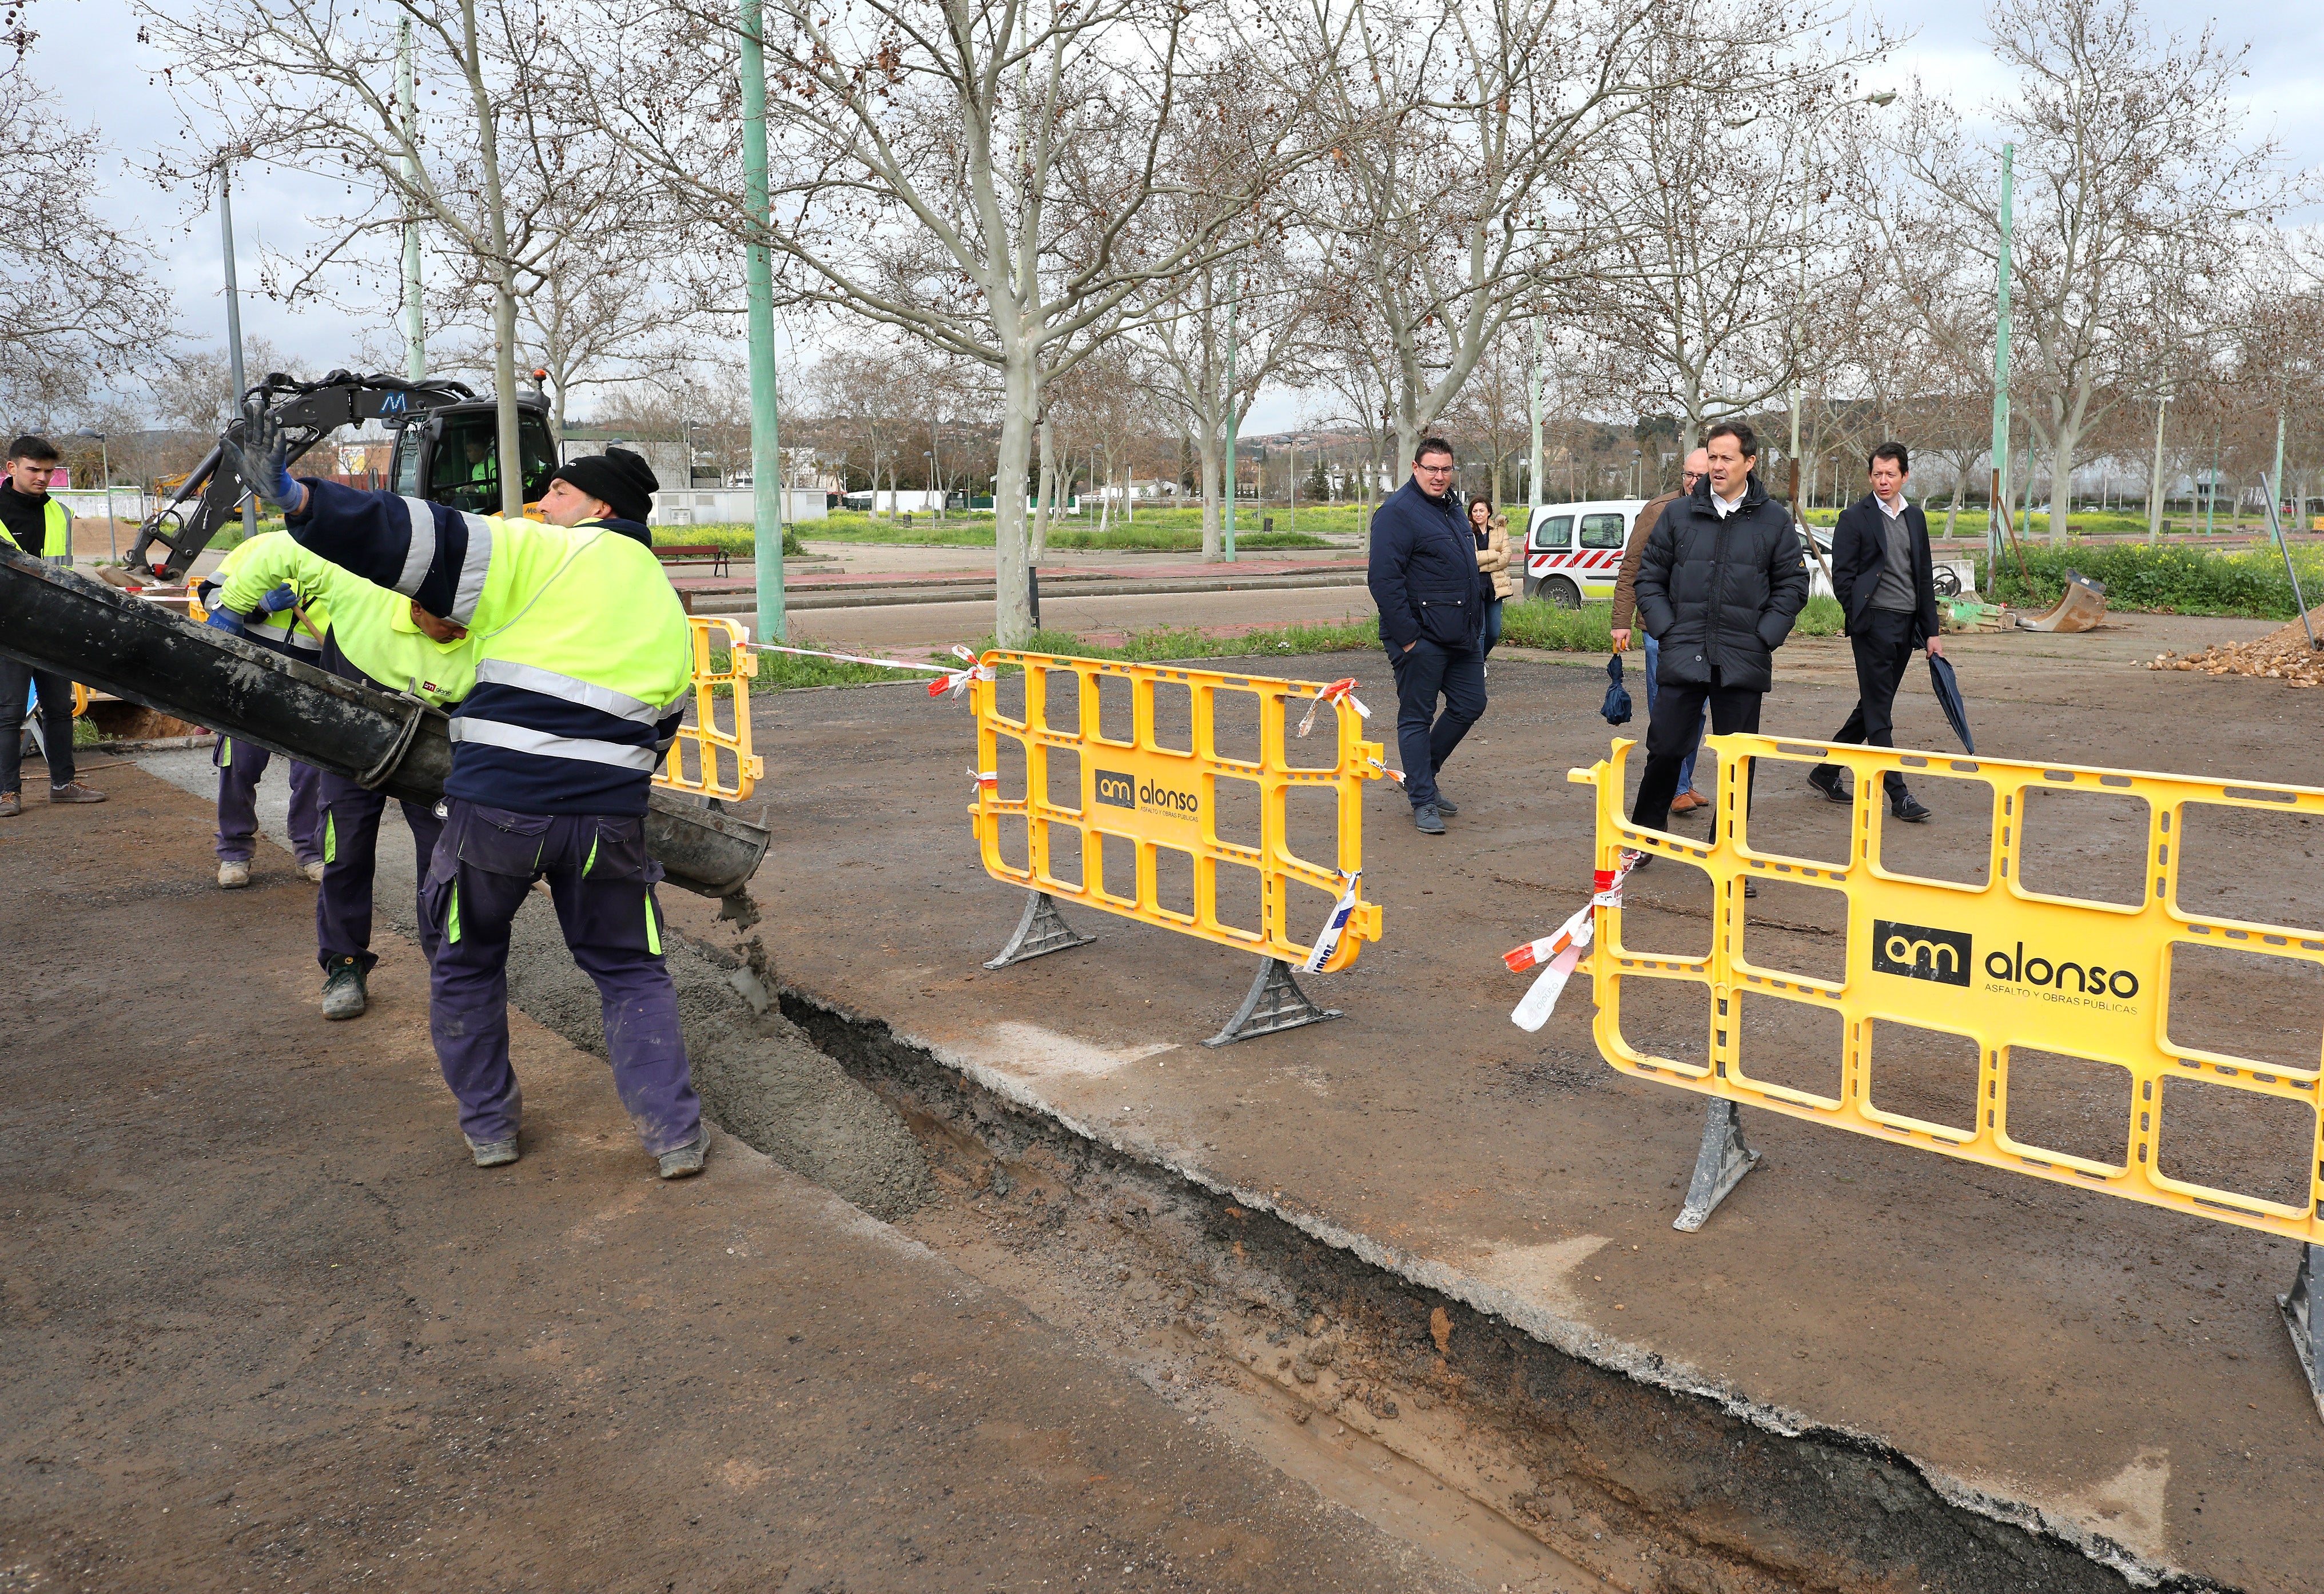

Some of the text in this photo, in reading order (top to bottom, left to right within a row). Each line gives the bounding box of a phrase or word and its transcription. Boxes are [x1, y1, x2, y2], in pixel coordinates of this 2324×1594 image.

[1100, 778, 1198, 812] am alonso
[1140, 806, 1159, 815] ASFALTO
[1162, 810, 1177, 818] OBRAS
[1885, 935, 2139, 999] am alonso
[1984, 983, 2138, 1015] ASFALTO Y OBRAS PÚBLICAS
